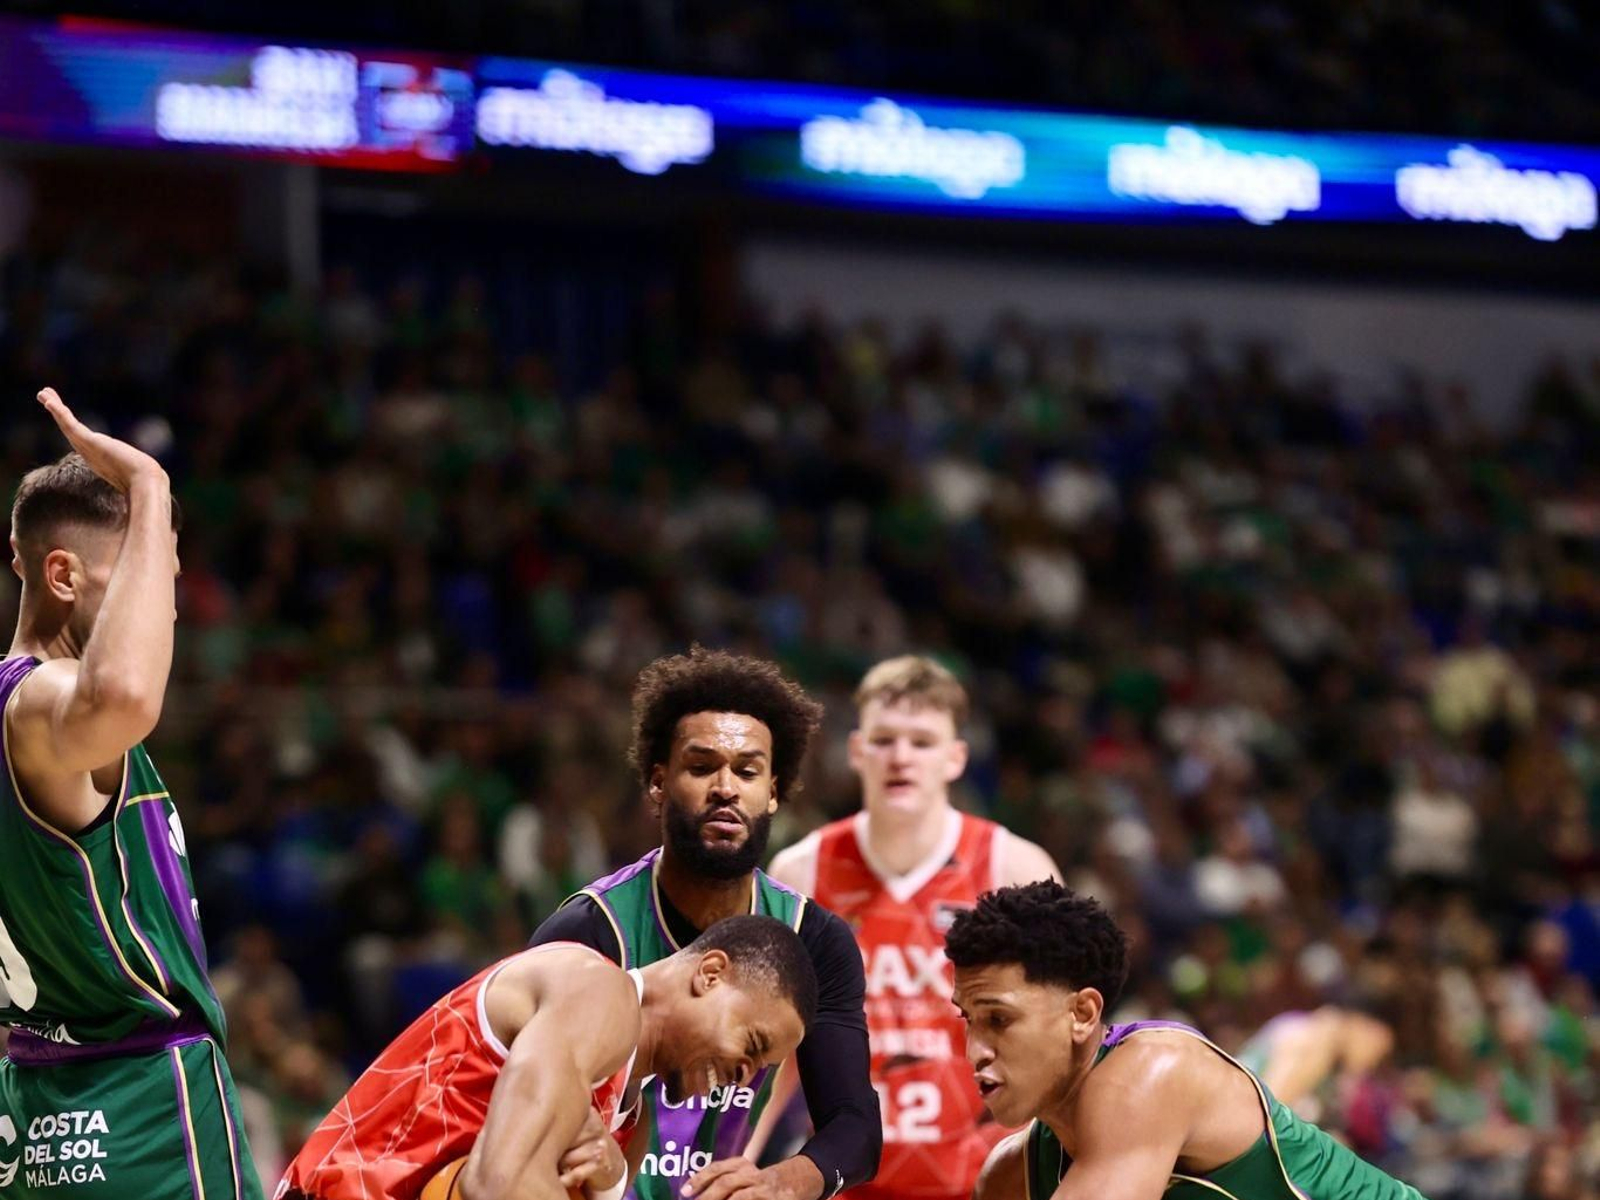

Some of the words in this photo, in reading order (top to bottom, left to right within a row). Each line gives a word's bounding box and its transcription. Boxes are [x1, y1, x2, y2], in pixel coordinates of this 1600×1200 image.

[28, 1109, 109, 1141] COSTA
[24, 1143, 56, 1165] DEL
[59, 1138, 108, 1161] SOL
[25, 1162, 107, 1189] MÁLAGA
